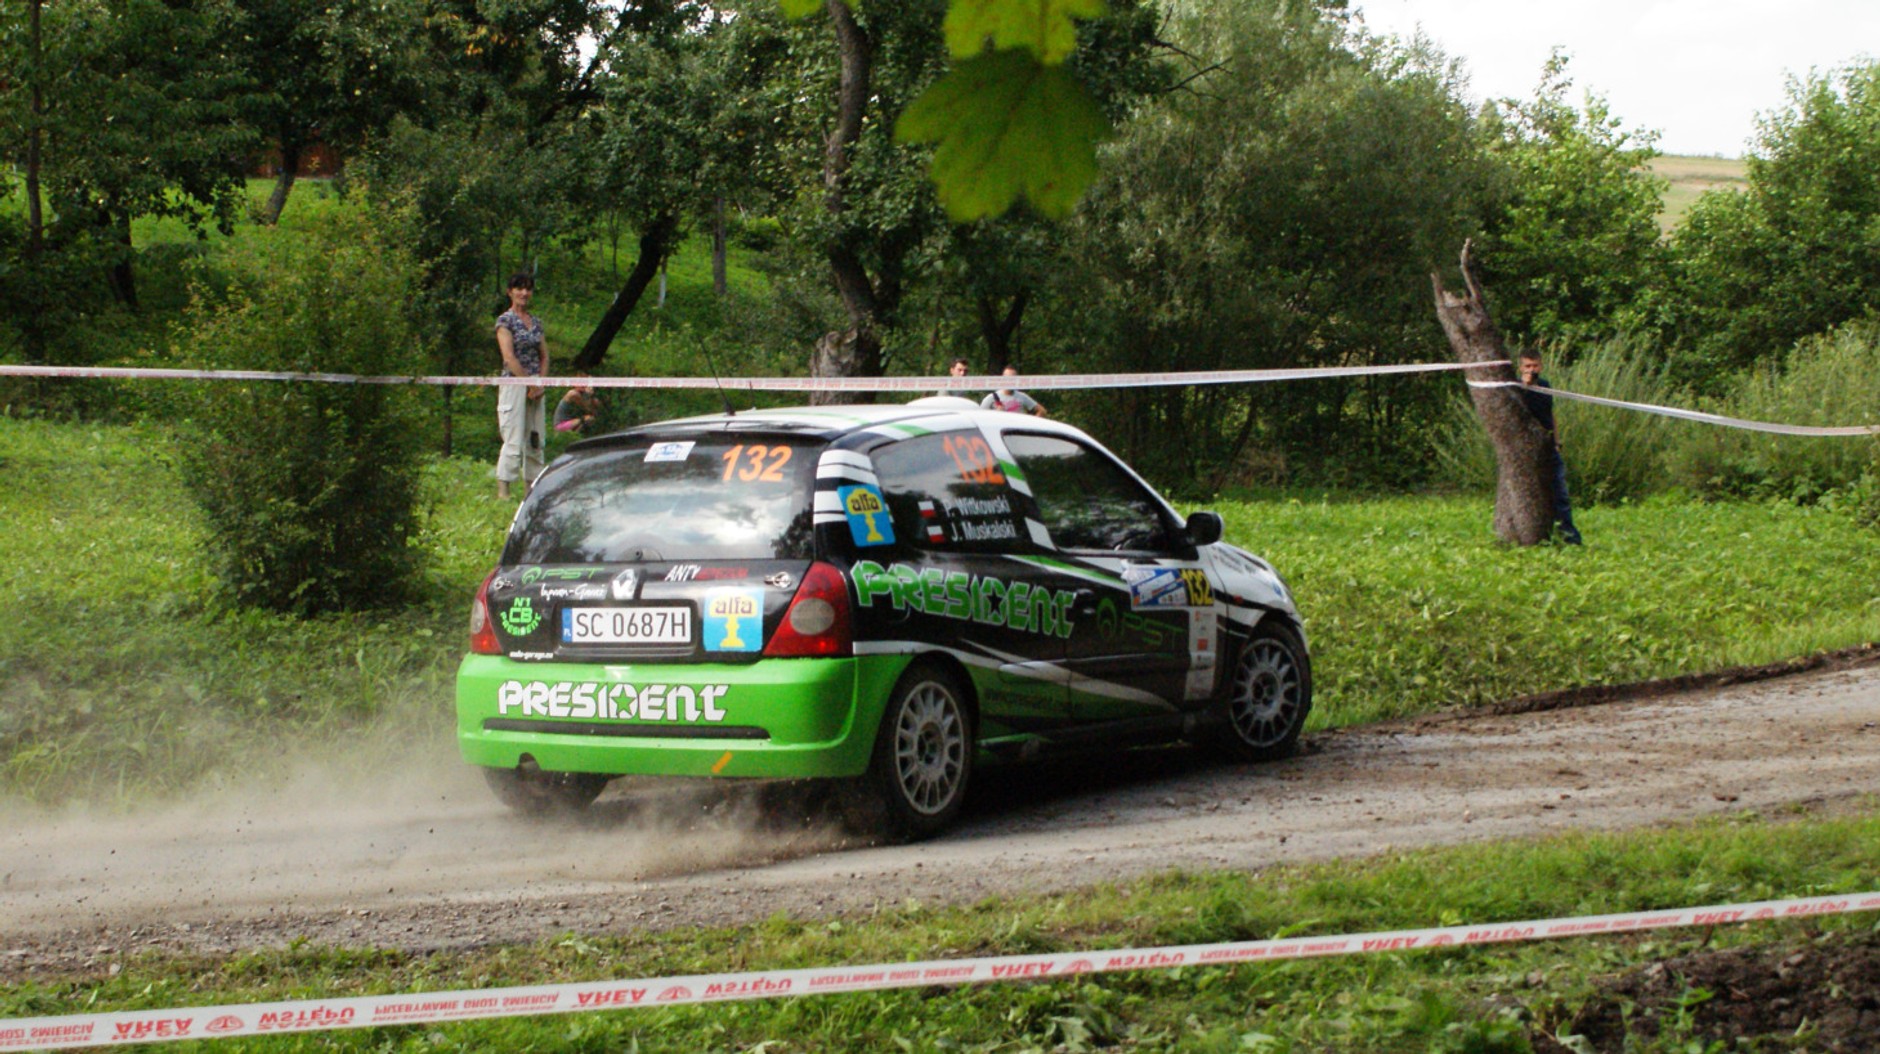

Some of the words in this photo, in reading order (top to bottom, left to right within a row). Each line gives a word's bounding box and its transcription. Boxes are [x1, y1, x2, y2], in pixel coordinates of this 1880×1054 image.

[722, 444, 793, 482] 132
[943, 435, 1005, 485] 132
[851, 494, 880, 512] alfa
[956, 494, 1011, 516] Witkowski
[951, 524, 963, 542] J.
[962, 520, 1017, 540] Muskalski
[541, 567, 605, 579] PST
[850, 560, 1078, 639] PRESIDENT
[1179, 567, 1214, 607] 132
[509, 607, 533, 623] CB
[714, 595, 753, 615] alfa
[500, 611, 542, 636] PRESIDENT
[576, 612, 604, 638] SC
[612, 612, 687, 638] 0687H
[1120, 611, 1186, 649] PST
[498, 680, 730, 722] PRESIDENT
